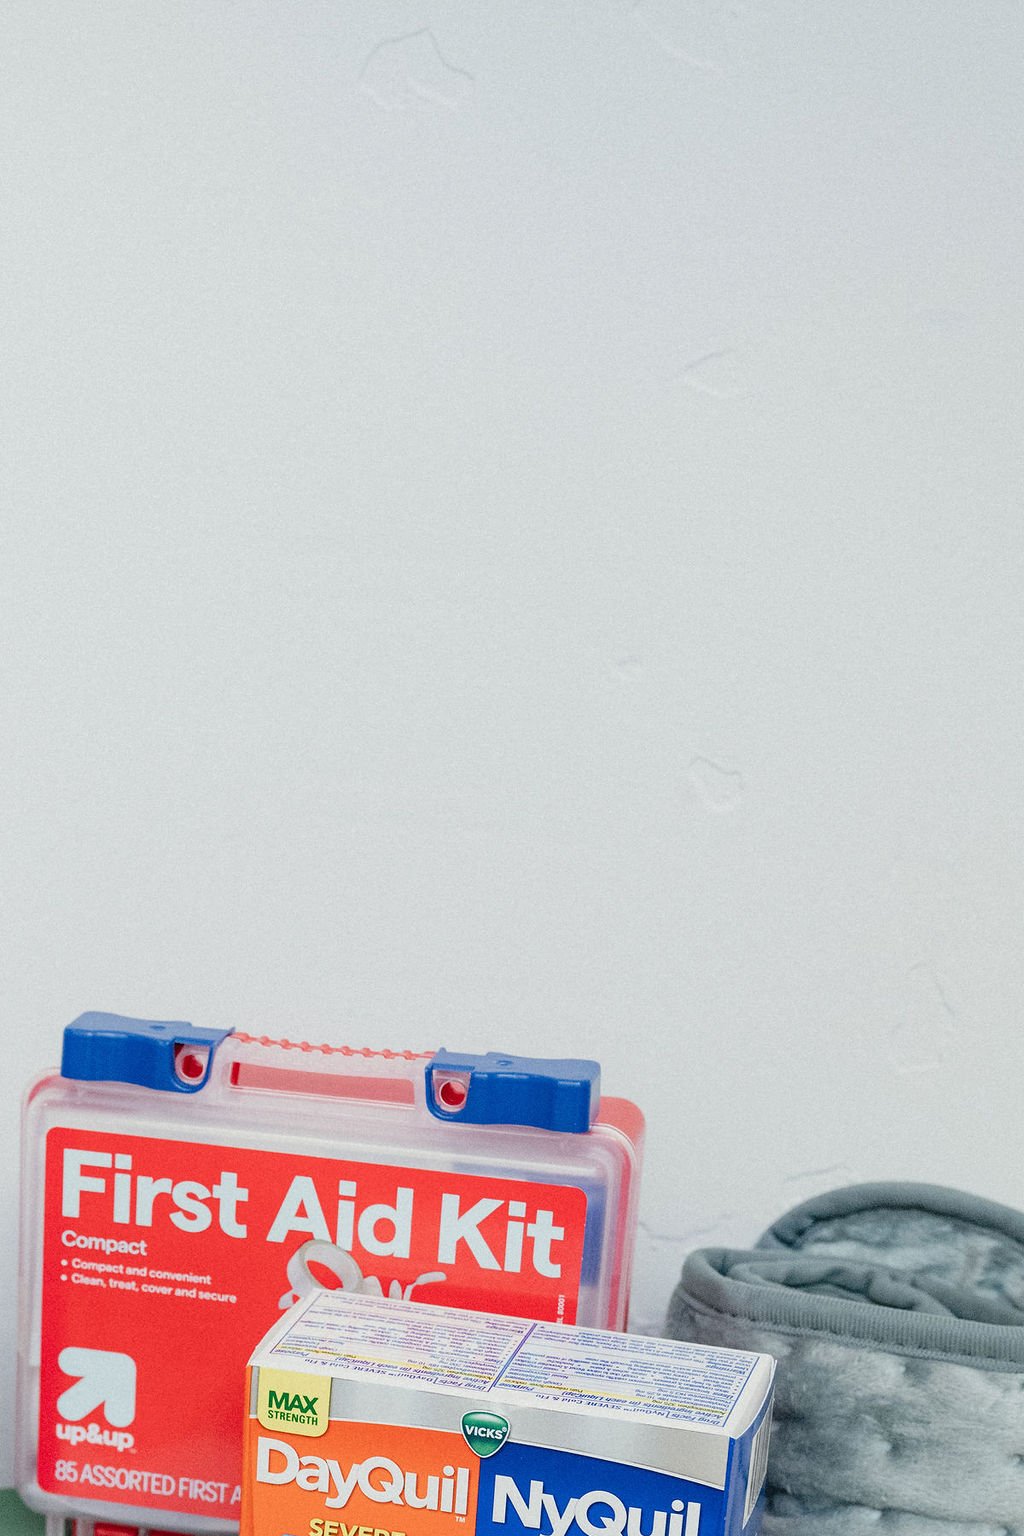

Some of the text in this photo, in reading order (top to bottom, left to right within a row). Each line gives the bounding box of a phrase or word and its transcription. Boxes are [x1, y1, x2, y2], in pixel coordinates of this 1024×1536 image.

[62, 1148, 566, 1279] First Aid Kit
[61, 1230, 148, 1256] Compact
[268, 1390, 318, 1416] MAX
[268, 1410, 318, 1426] STRENGTH
[56, 1423, 134, 1452] up&up
[464, 1425, 504, 1440] VICKS
[55, 1460, 229, 1503] 85 ASSORTED FIRST
[256, 1436, 469, 1515] DayQuil
